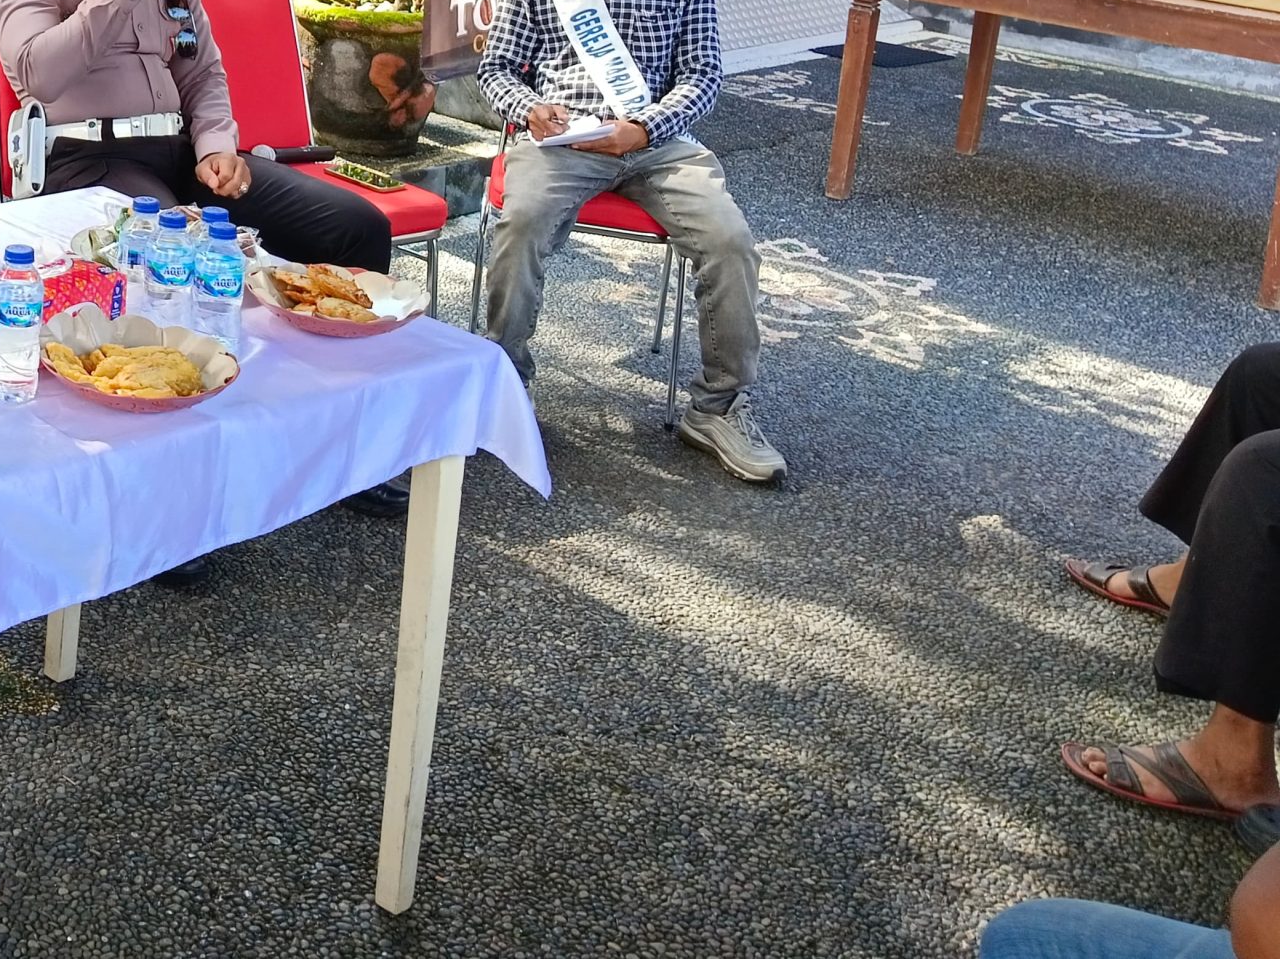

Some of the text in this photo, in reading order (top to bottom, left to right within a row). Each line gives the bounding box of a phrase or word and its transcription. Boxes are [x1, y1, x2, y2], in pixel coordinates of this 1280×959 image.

[570, 8, 616, 58] GEREJA
[163, 266, 187, 277] AQUA
[213, 278, 237, 288] AQUA
[5, 305, 31, 317] AQUA
